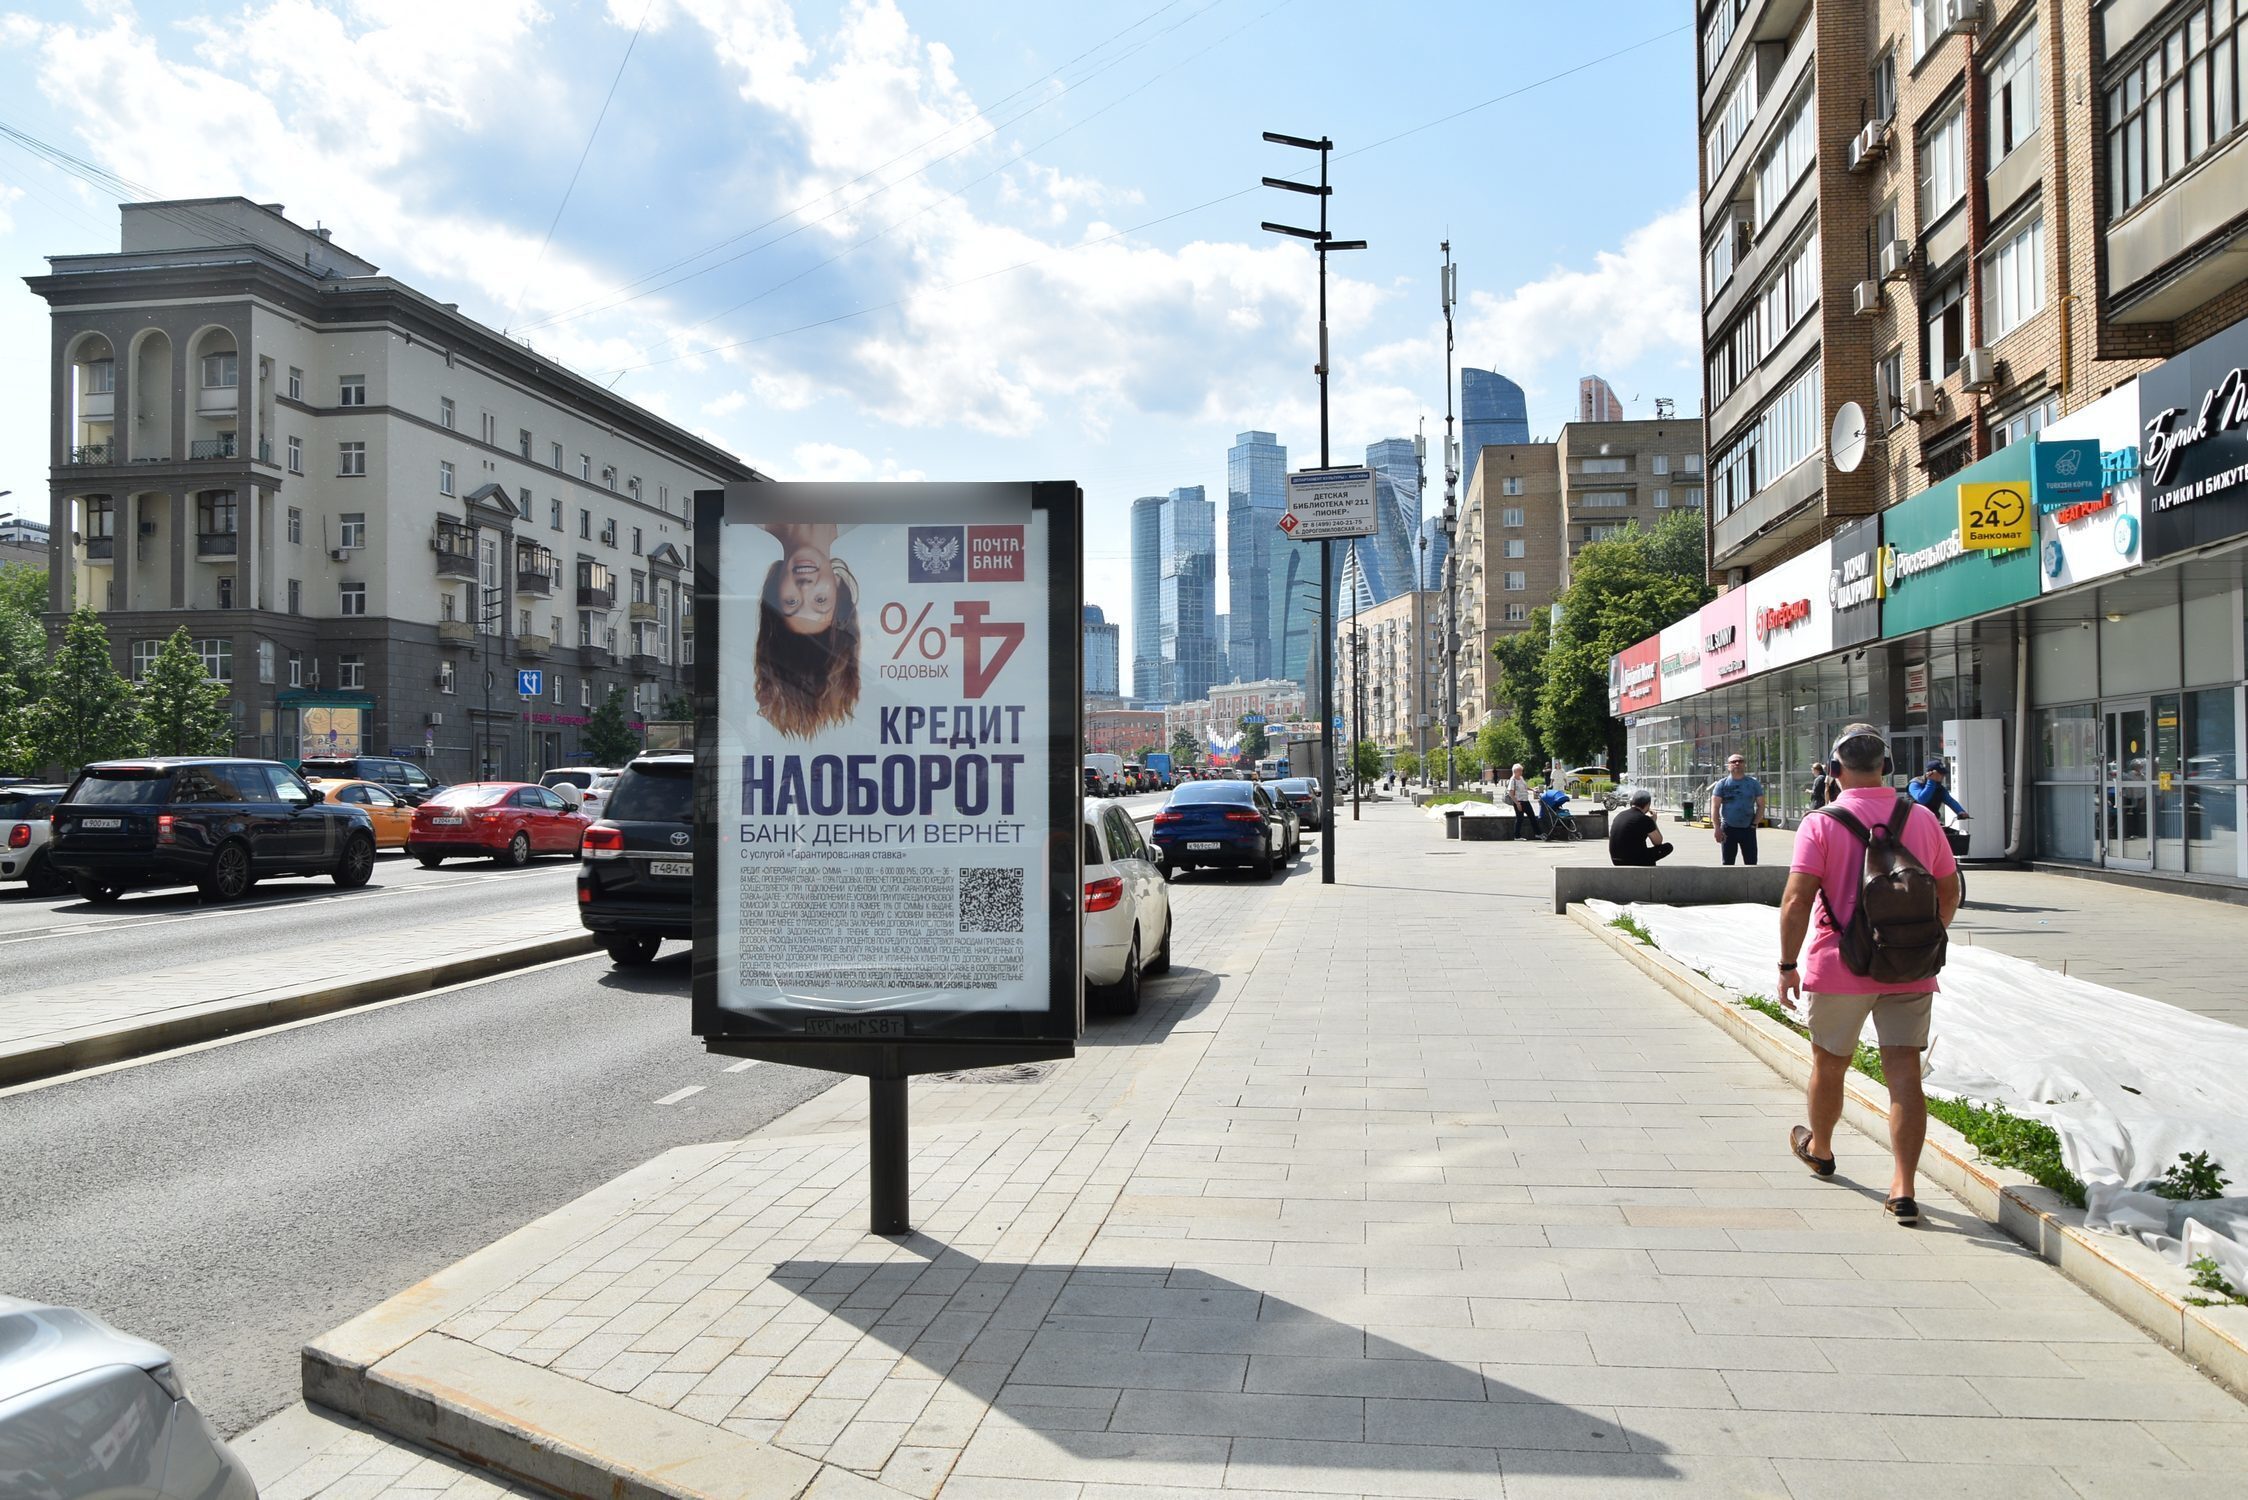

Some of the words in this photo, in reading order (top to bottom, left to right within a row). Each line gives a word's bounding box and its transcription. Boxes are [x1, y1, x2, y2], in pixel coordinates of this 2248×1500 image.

[2144, 388, 2213, 486] Бутик
[1313, 491, 1348, 500] ДЕТСКАЯ
[2151, 484, 2194, 513] ПАРИКИ
[2196, 480, 2204, 498] И
[1293, 501, 1344, 509] БИБЛИОТЕКА
[2057, 503, 2081, 525] MEAT
[1970, 510, 2000, 528] 24
[1301, 526, 1355, 535] ДОРОГОМИЛОВСКАЯ
[1970, 531, 2022, 541] Банкомат
[973, 538, 1019, 552] ПОЧТА
[973, 556, 1013, 569] БАНК
[1843, 552, 1869, 583] ХОЧУ
[1838, 575, 1875, 609] ШАУРМУ
[880, 664, 949, 681] ГОДОВЫХ
[880, 705, 1025, 750] КРЕДИТ
[741, 754, 1025, 817] НАОБОРОТ
[740, 824, 806, 844] БАНК
[812, 824, 915, 847] ДЕНЬГИ
[924, 820, 1025, 844] ВЕРНЁТ
[741, 850, 748, 860] С
[749, 850, 786, 862] услугой
[787, 850, 870, 862] «Гарантированная
[872, 850, 907, 860] ставка»
